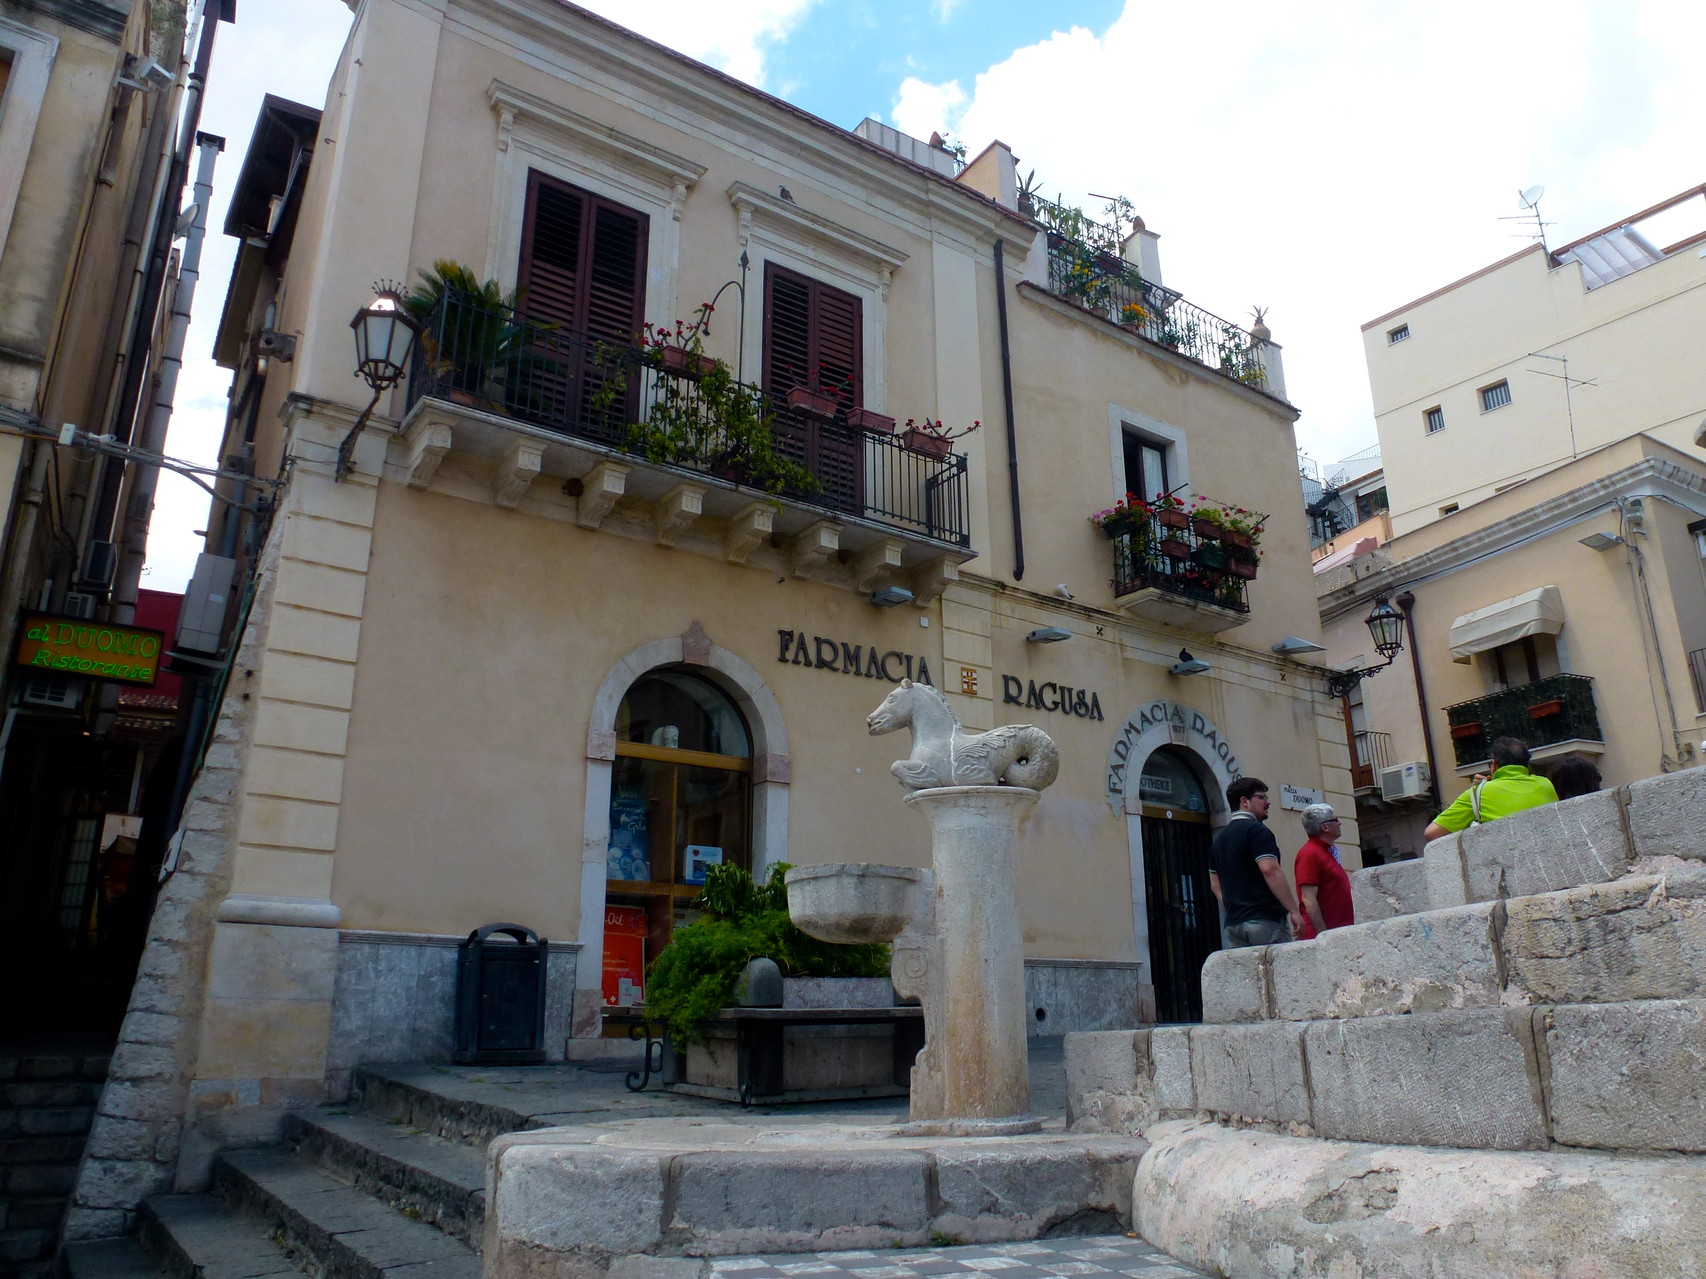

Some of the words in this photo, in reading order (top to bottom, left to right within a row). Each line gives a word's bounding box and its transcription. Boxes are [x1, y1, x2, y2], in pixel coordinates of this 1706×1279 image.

[27, 624, 49, 642] al
[53, 623, 158, 658] DUOMO
[31, 649, 152, 680] Ristorante
[777, 629, 935, 687] FARMACIA
[1002, 674, 1105, 721] RAGUSA
[1140, 777, 1170, 792] OTHEKE
[1293, 795, 1314, 805] DUOMO
[605, 912, 624, 926] Oil
